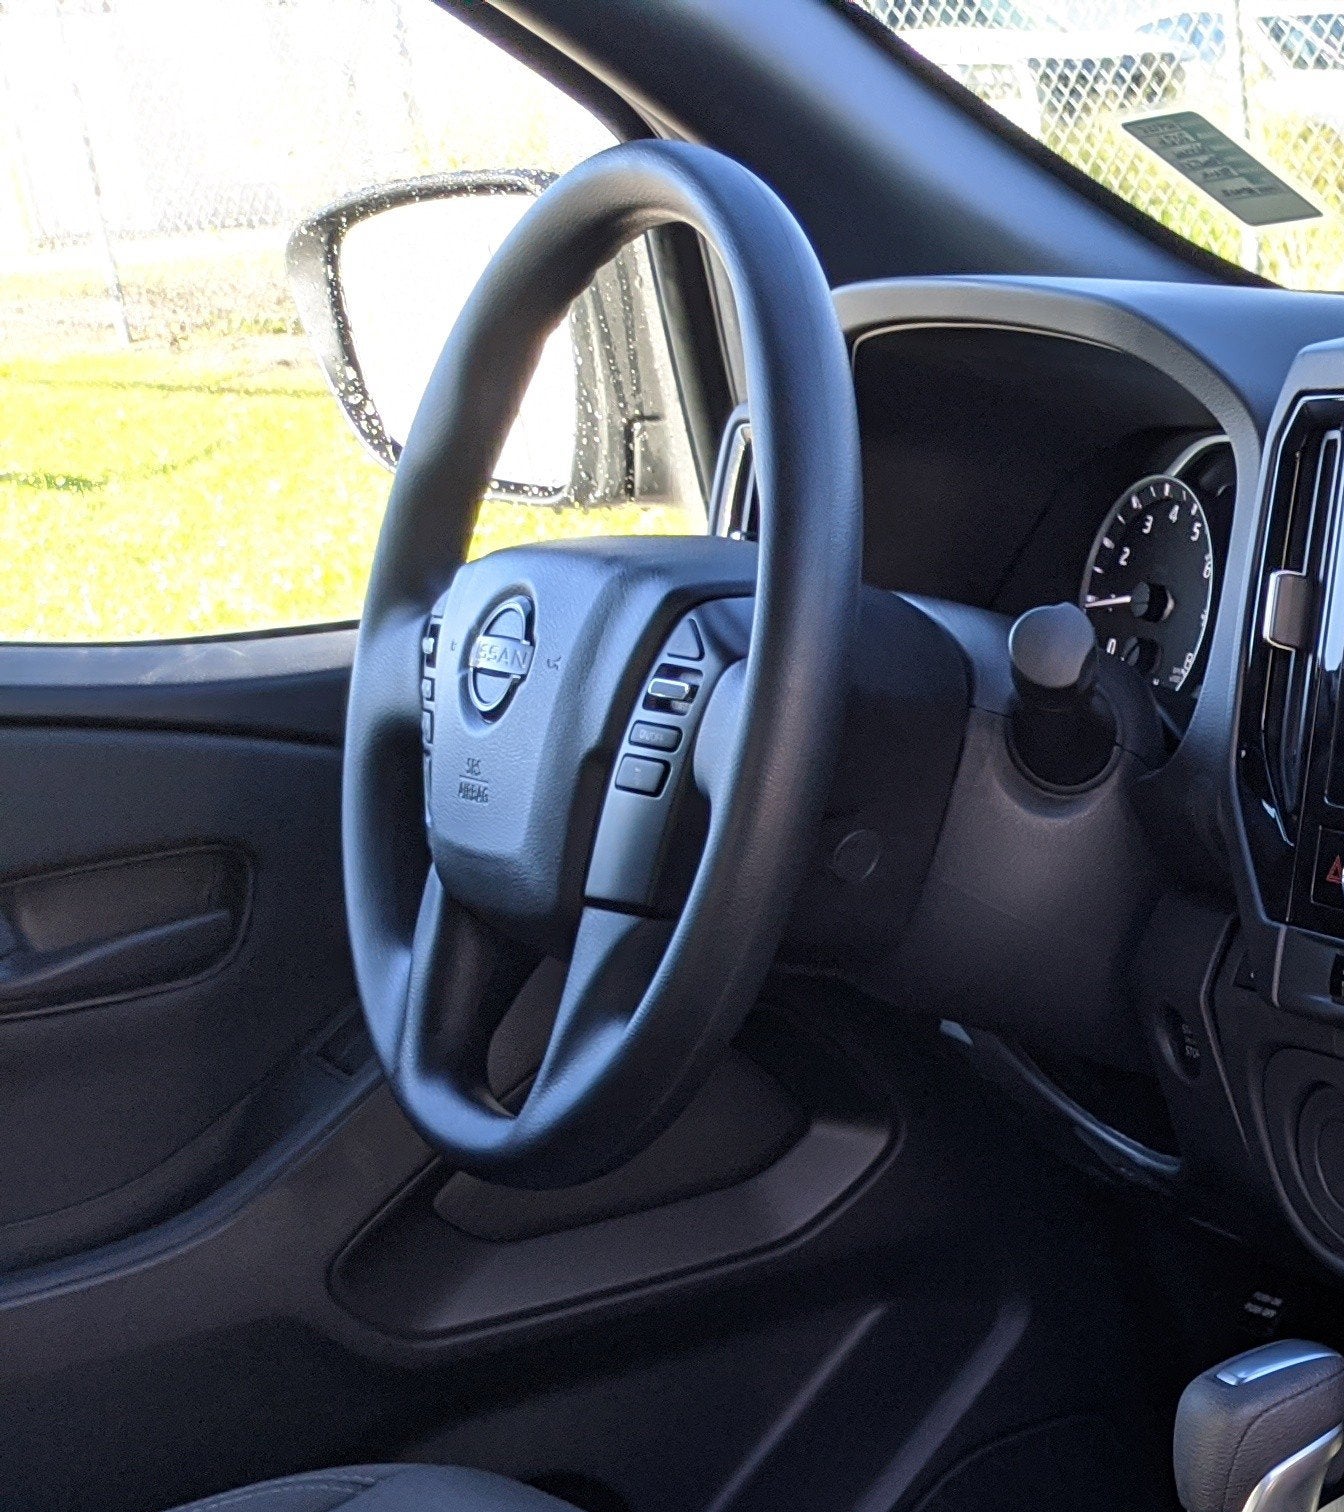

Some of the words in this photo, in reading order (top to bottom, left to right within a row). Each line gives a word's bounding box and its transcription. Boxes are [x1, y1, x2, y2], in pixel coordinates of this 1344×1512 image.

[1168, 505, 1180, 523] 4
[1142, 515, 1154, 534] 3
[1190, 522, 1201, 541] 5
[1119, 546, 1131, 566] 2
